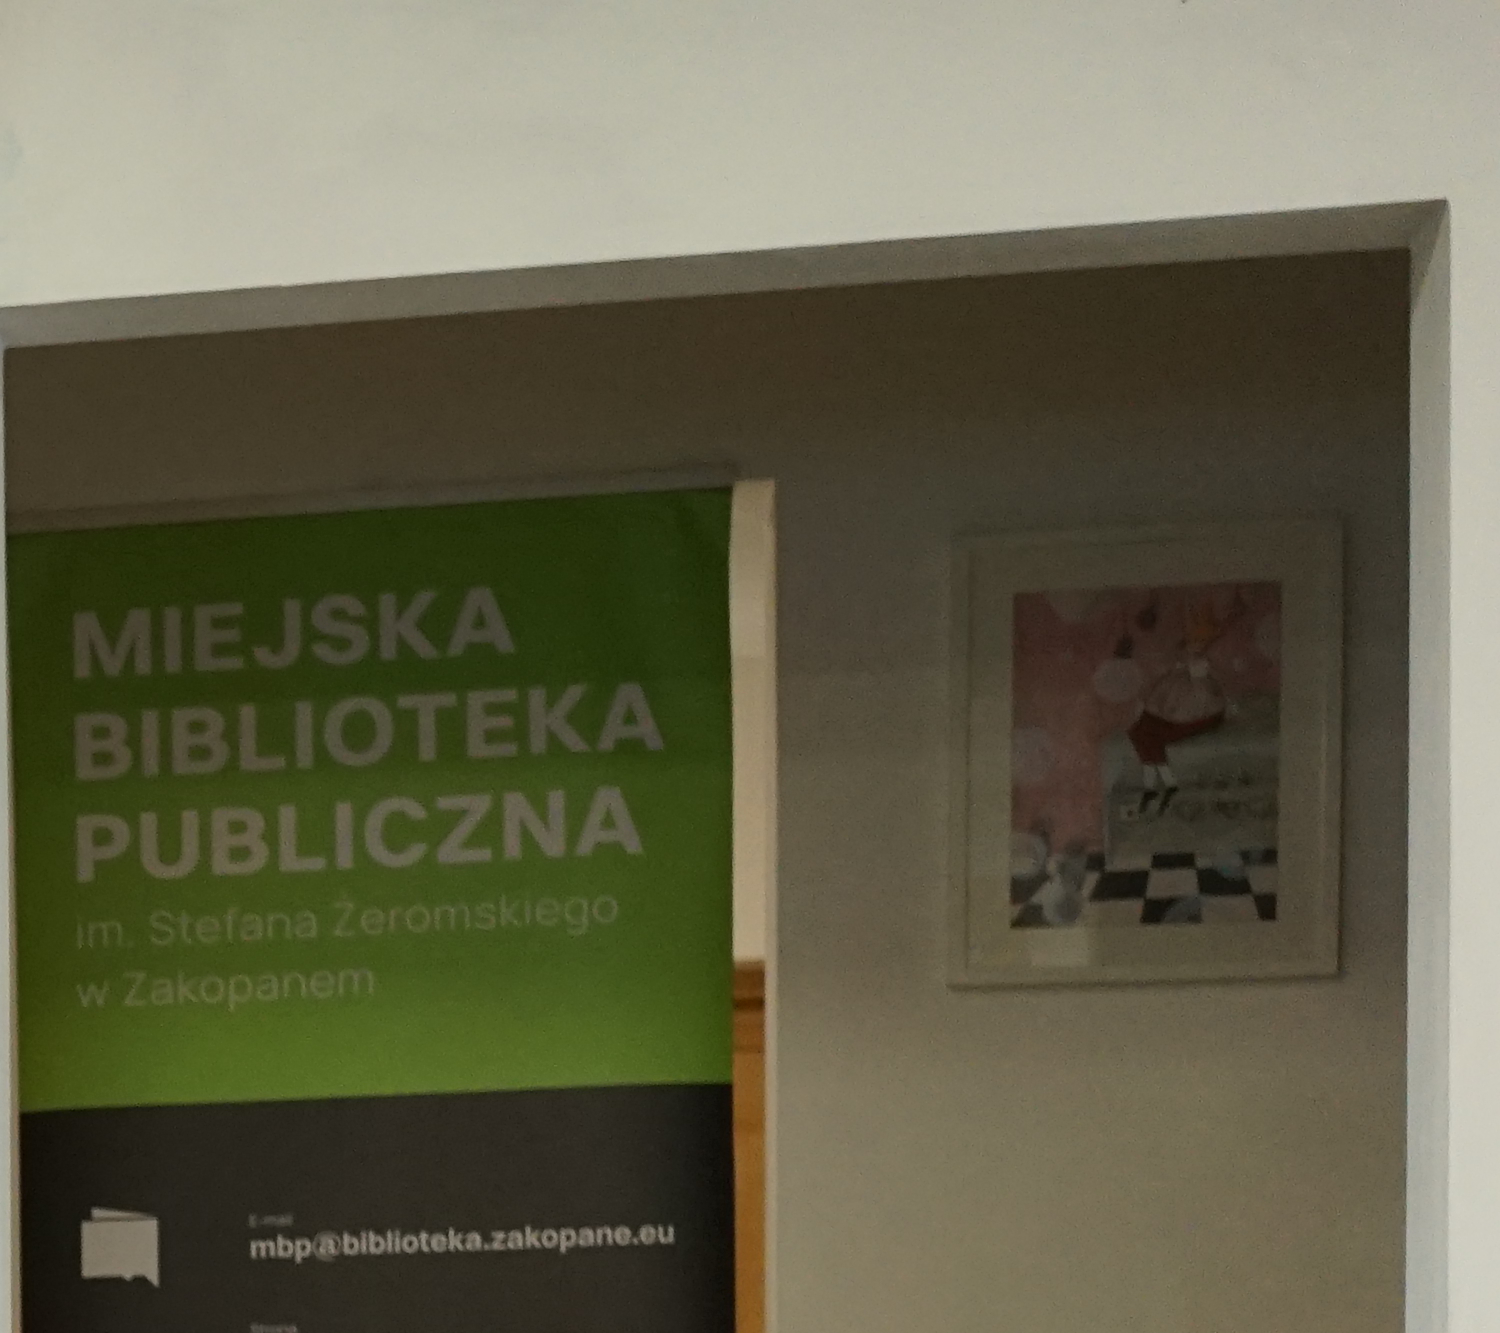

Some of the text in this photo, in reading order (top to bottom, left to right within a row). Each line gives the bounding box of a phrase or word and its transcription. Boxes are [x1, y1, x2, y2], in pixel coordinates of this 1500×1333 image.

[72, 586, 516, 679] MIEJSKA
[74, 682, 665, 781] BIBLIOTEKA
[75, 785, 644, 883] PUBLICZNA
[76, 892, 620, 951] im. Stefana Żeromskiego
[77, 964, 376, 1012] w Zakopanem
[249, 1223, 676, 1264] mbp@biblioteka.zakopane.eu
